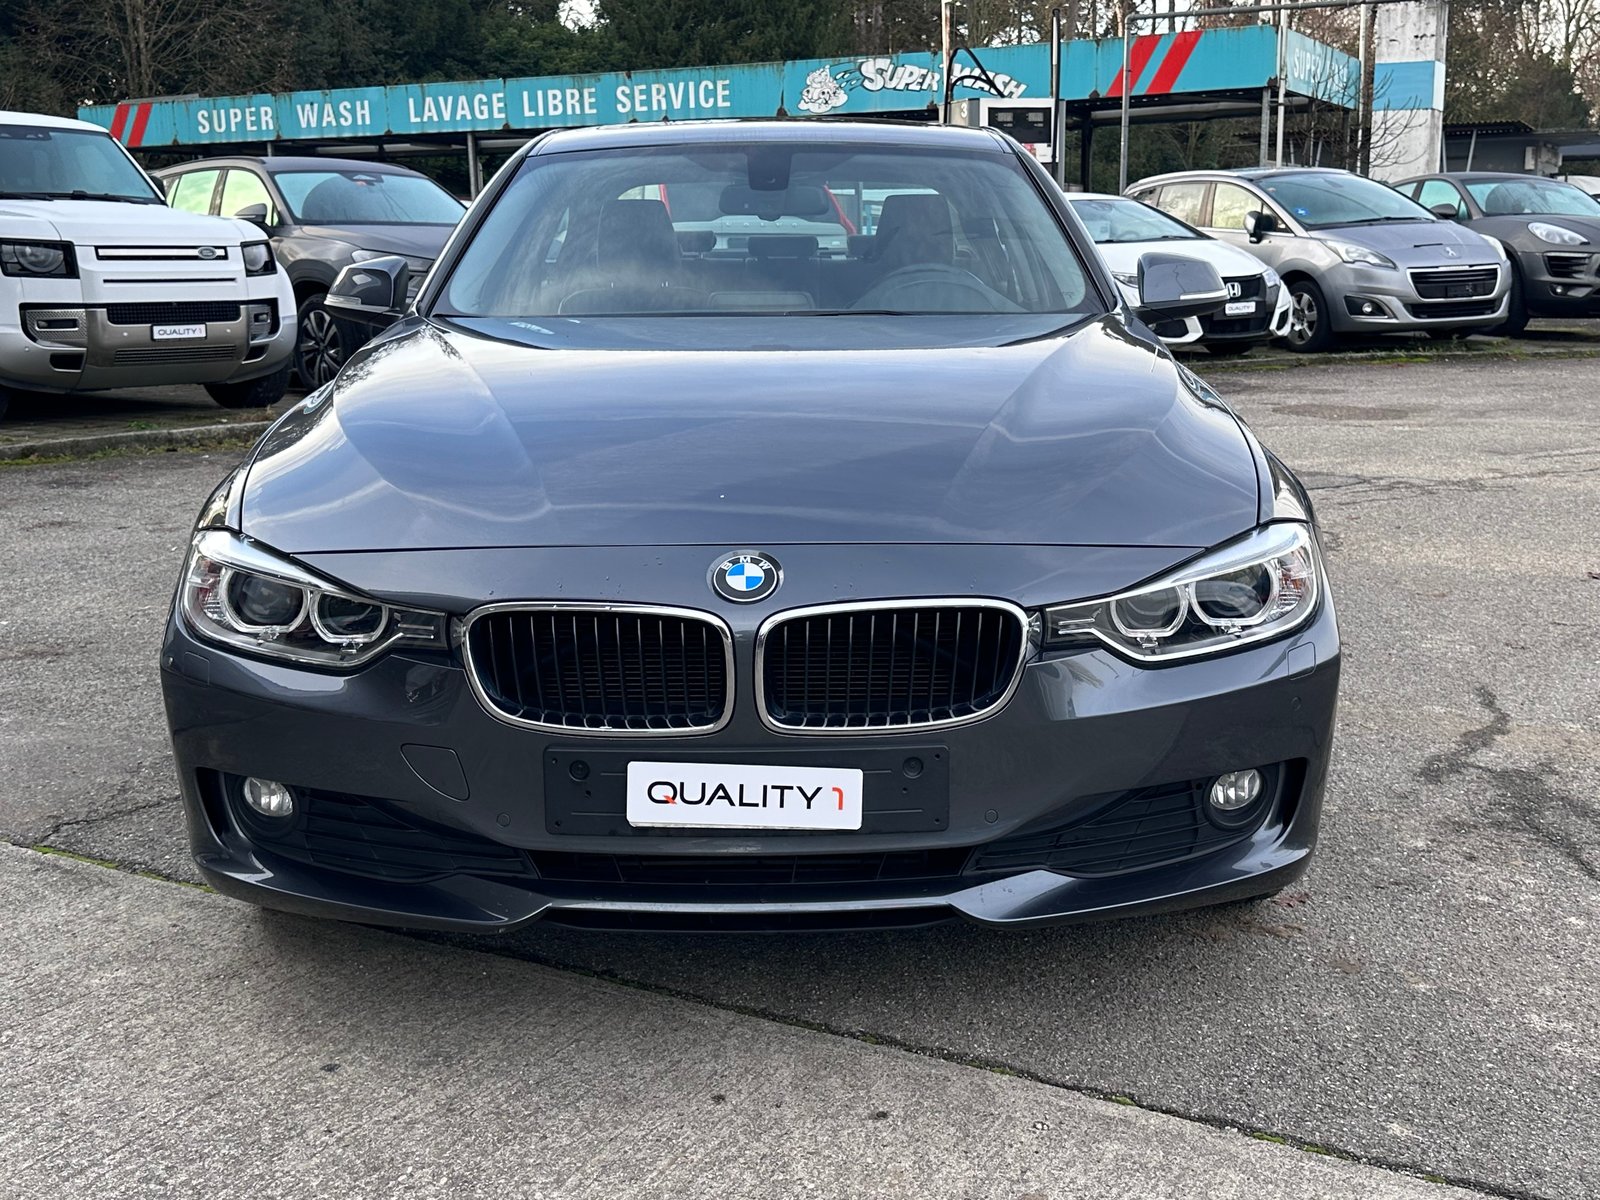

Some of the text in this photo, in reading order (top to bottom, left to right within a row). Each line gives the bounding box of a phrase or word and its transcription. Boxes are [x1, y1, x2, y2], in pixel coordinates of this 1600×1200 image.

[858, 58, 940, 92] SUPER
[408, 79, 731, 123] LAVAGE LIBRE SERVICE
[960, 102, 968, 118] 3
[197, 100, 371, 134] SUPER WASH
[157, 328, 198, 336] QUALITY
[720, 555, 772, 571] BMW
[647, 780, 844, 811] QUALITY 1
